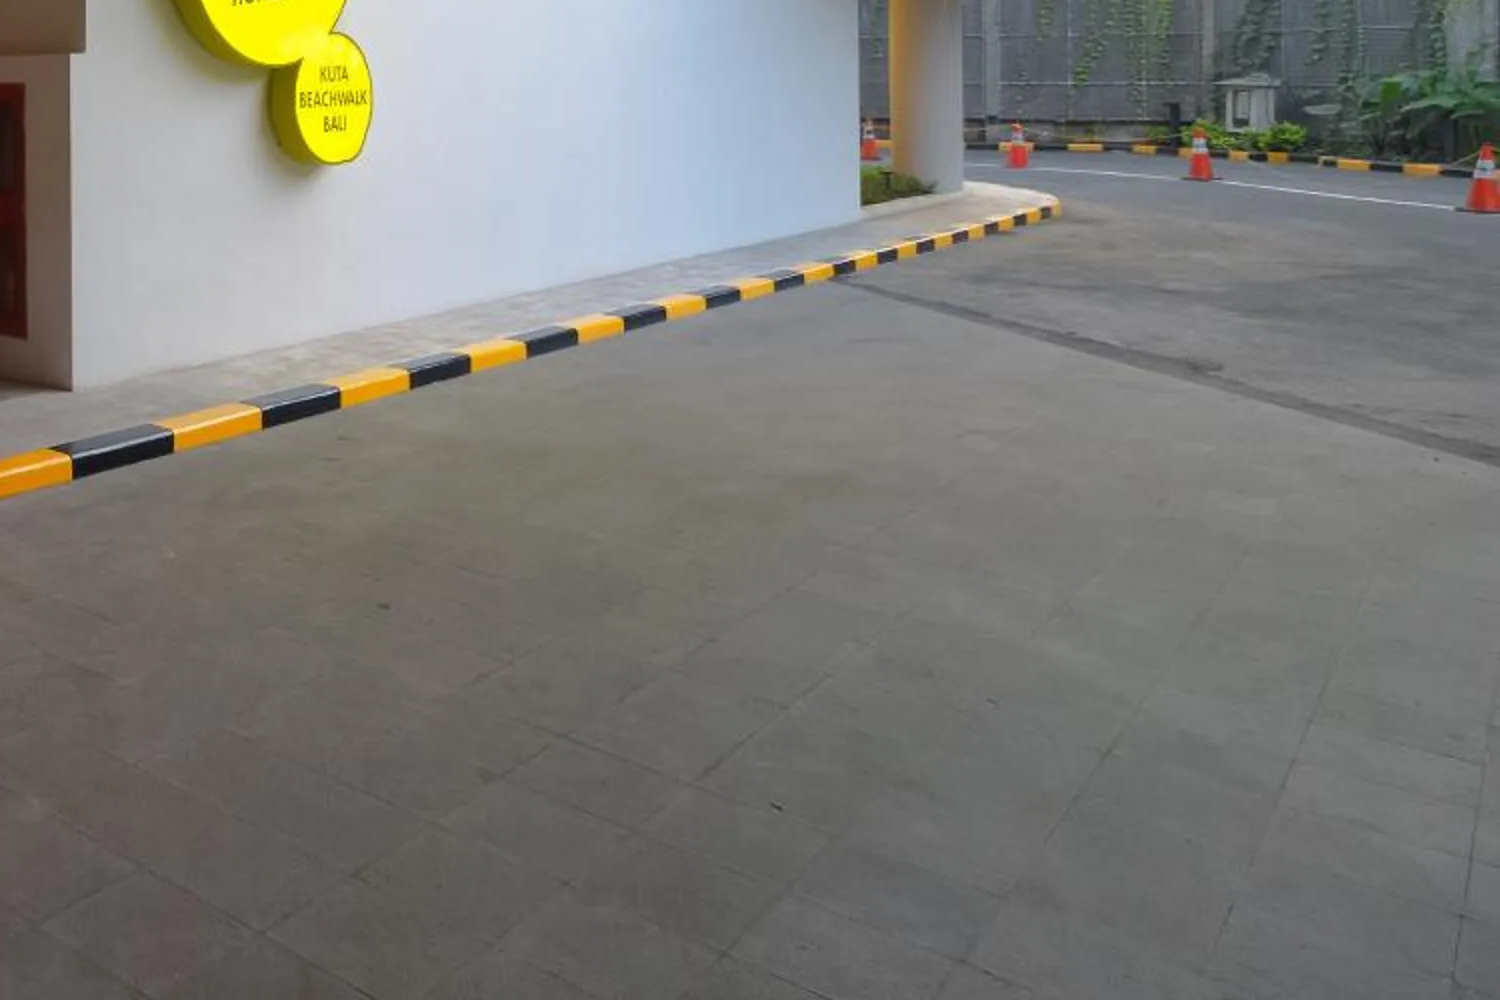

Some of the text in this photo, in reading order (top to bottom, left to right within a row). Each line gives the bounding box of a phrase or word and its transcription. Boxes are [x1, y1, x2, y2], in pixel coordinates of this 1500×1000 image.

[319, 65, 349, 82] KUTA
[299, 88, 368, 109] BEACHWALK
[323, 115, 347, 132] BALI
